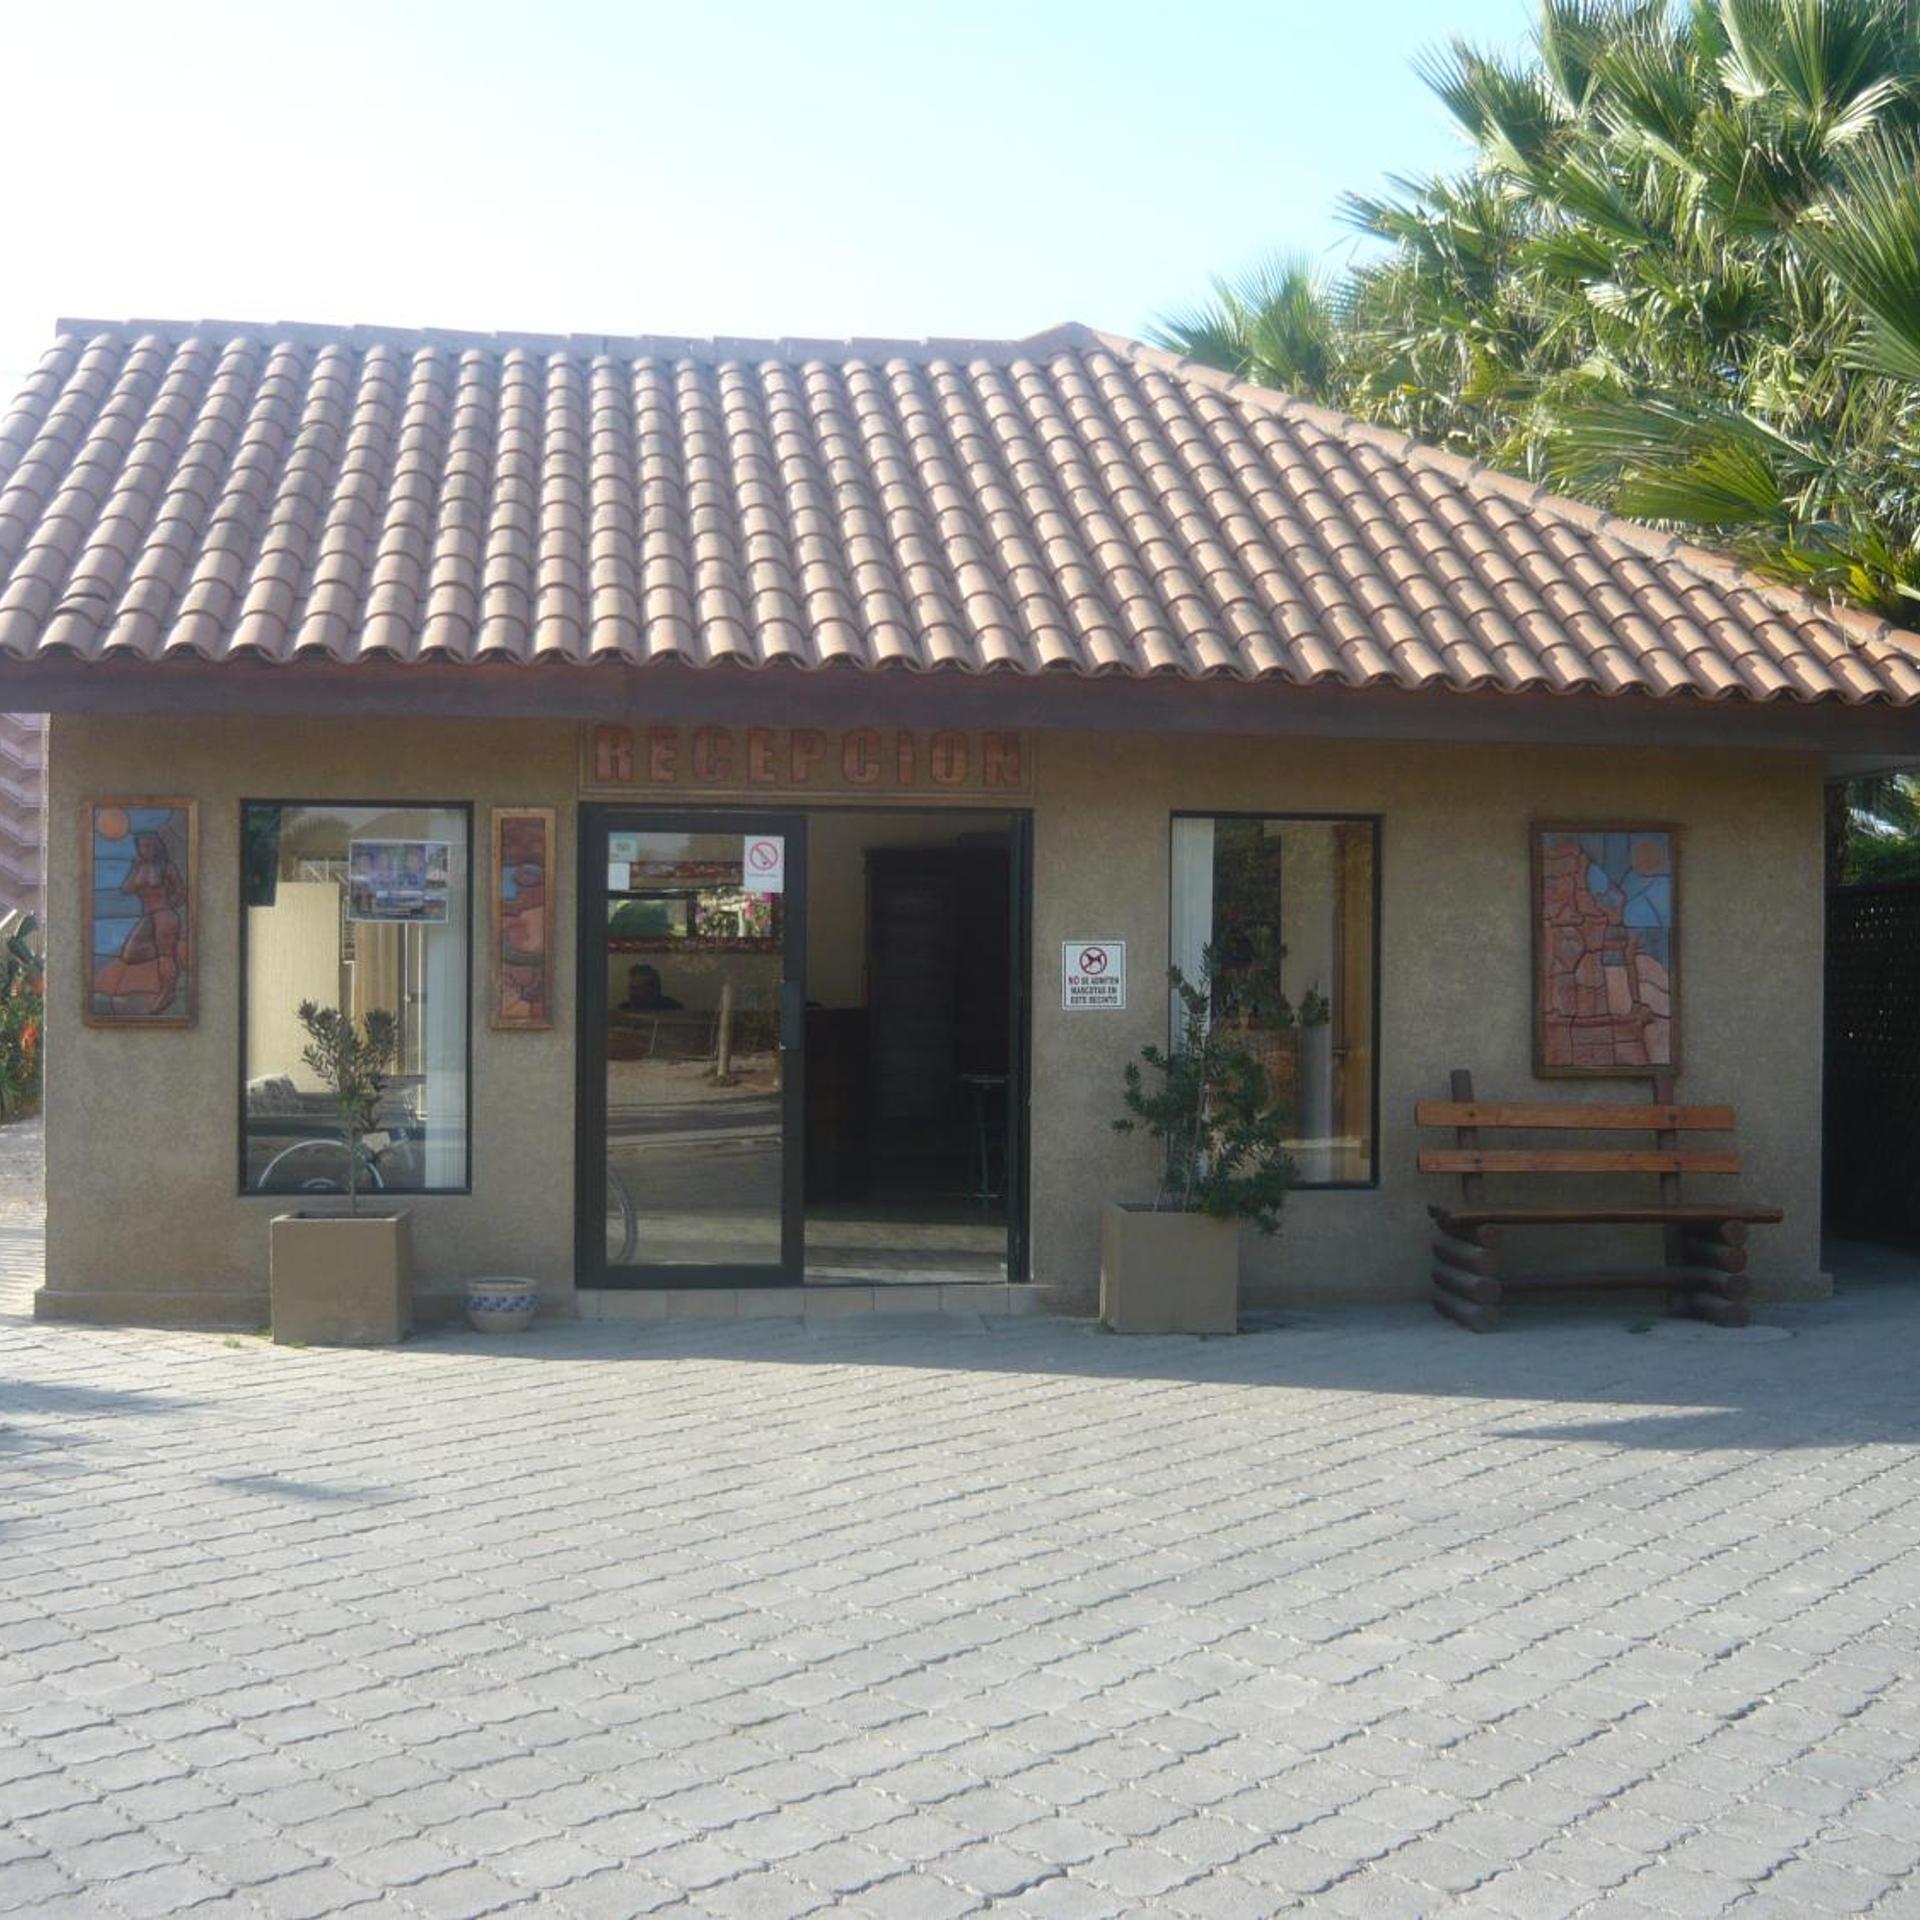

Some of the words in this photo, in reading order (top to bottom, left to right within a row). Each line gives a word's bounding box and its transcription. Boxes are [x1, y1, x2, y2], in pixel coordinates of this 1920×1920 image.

[1068, 976, 1080, 985] NO
[1071, 986, 1105, 994] MASCOTAS
[1107, 986, 1117, 994] EN
[1070, 996, 1087, 1004] ESTE
[1089, 996, 1117, 1004] RECINTO
